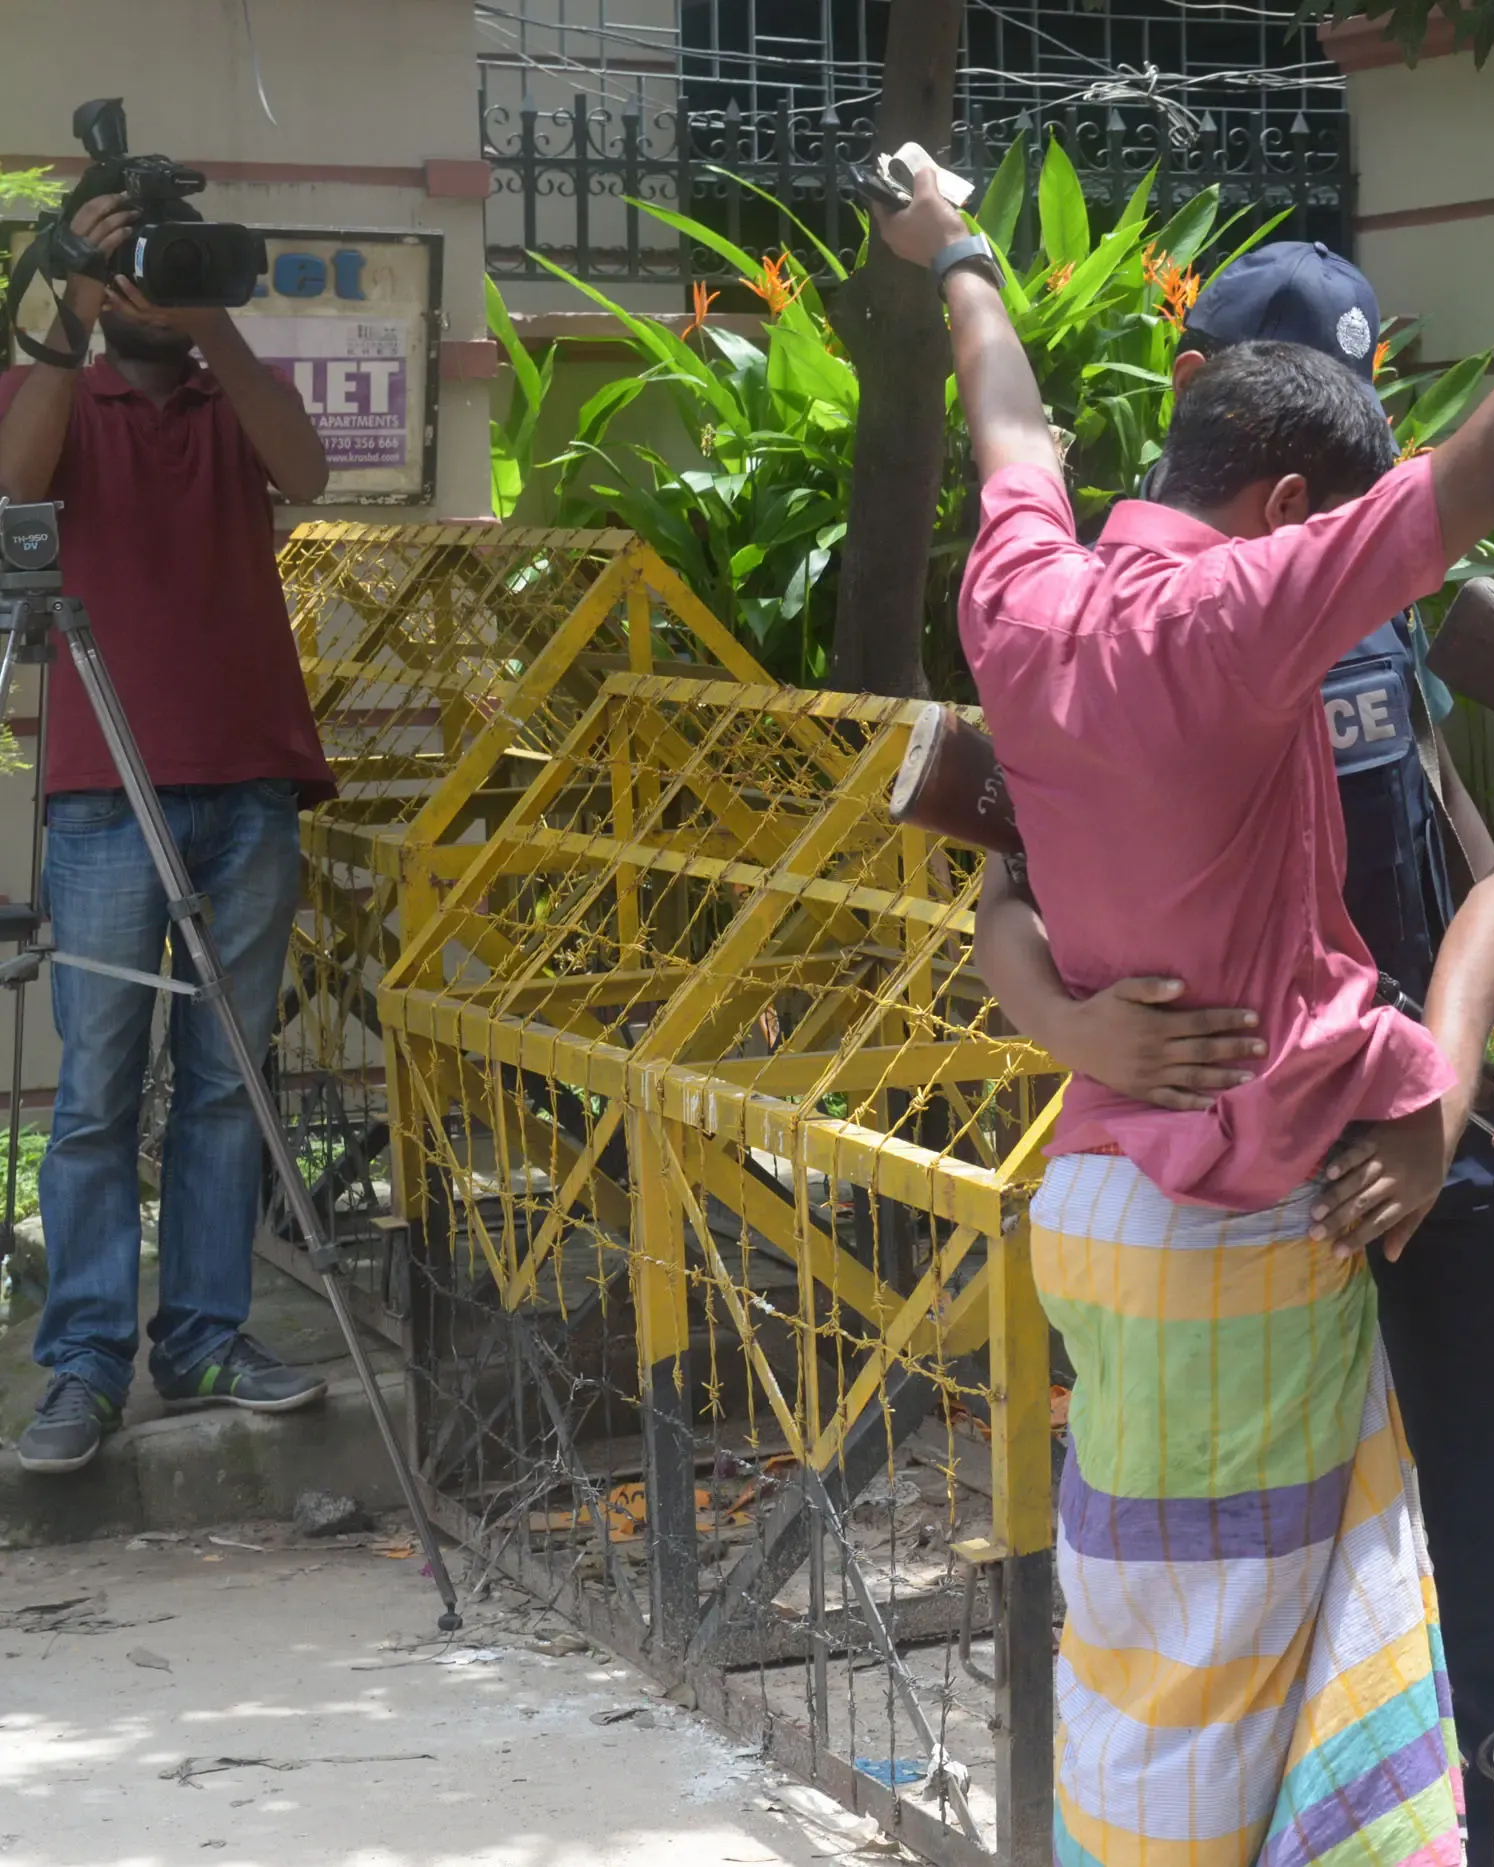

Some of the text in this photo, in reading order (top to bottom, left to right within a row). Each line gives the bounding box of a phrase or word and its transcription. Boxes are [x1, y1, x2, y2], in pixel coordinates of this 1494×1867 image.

[252, 249, 367, 301] et
[294, 361, 400, 414] LET
[318, 414, 400, 428] APARTMENTS
[354, 436, 375, 449] 356
[23, 542, 39, 551] DV
